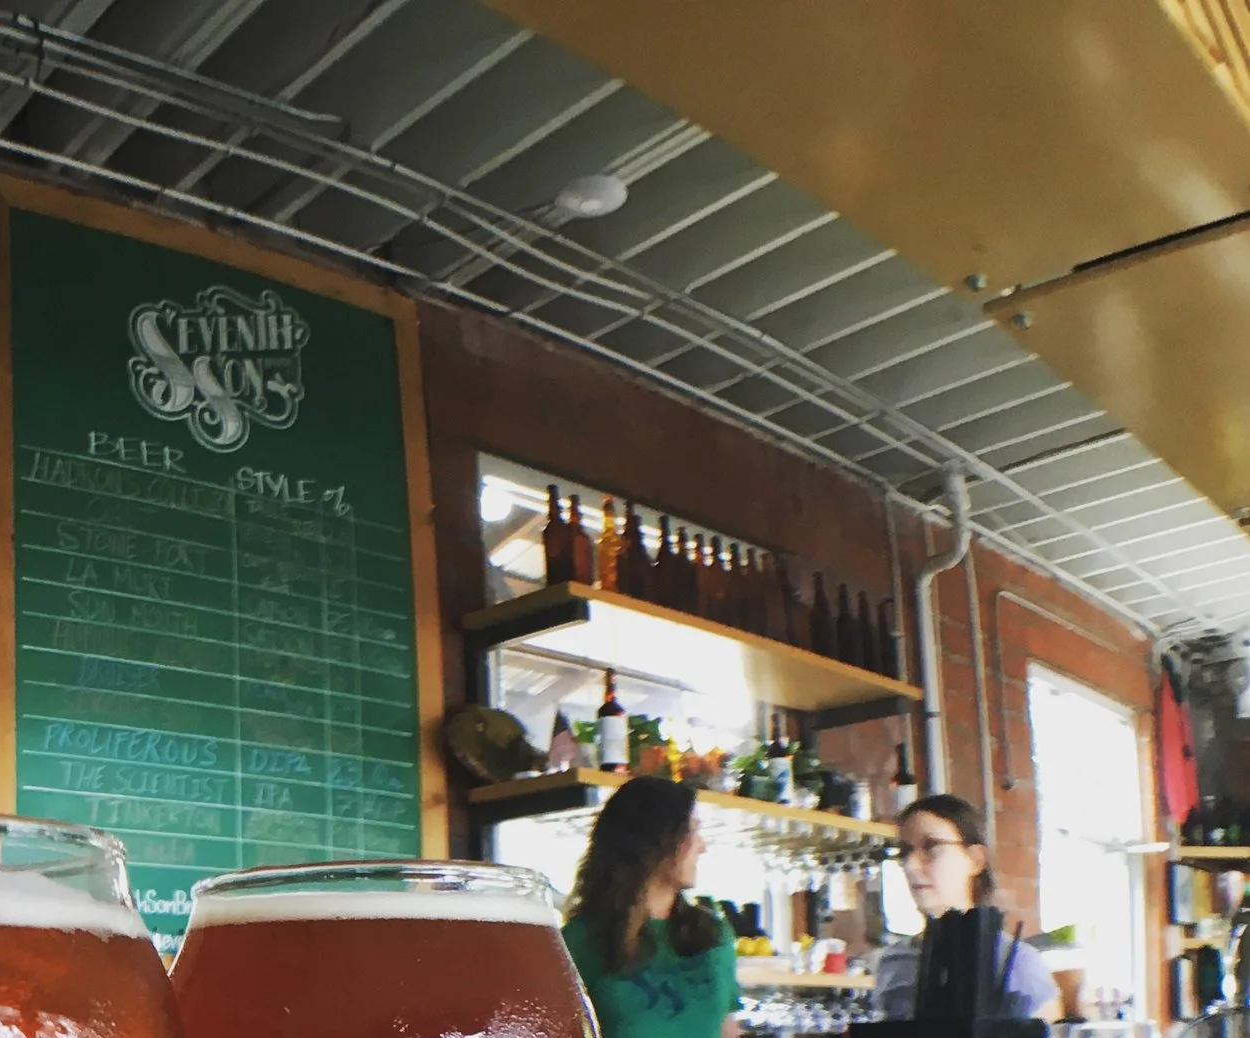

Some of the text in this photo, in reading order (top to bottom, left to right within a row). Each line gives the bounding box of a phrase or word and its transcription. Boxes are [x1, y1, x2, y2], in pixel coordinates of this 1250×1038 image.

[134, 305, 302, 413] SEVENTH
[88, 430, 188, 475] BEER
[236, 466, 317, 504] STYLE
[43, 722, 219, 767] PROLIFEROUS
[59, 760, 106, 790] THE
